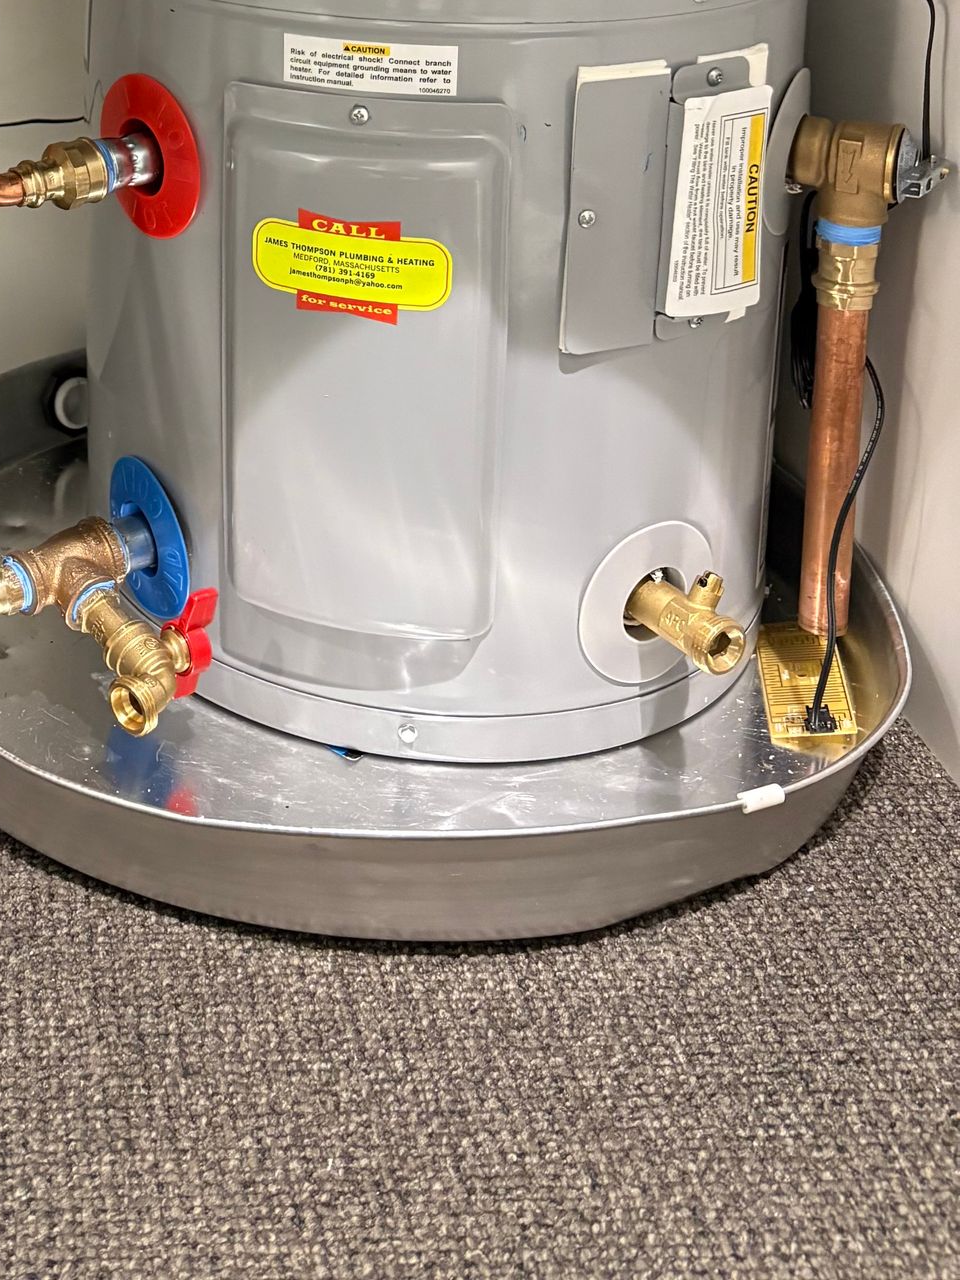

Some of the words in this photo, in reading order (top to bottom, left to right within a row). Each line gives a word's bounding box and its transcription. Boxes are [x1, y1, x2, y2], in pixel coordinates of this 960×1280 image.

[321, 53, 354, 61] electrical
[388, 58, 420, 66] Connect
[351, 46, 385, 54] CAUTION
[290, 57, 311, 65] circuit
[313, 60, 349, 69] equipment
[352, 64, 389, 74] grounding
[290, 65, 312, 73] heater.
[335, 71, 364, 79] detailed
[370, 73, 413, 82] information
[290, 73, 325, 83] instruction
[326, 79, 354, 87] manual.
[739, 127, 747, 160] Improper
[728, 174, 736, 205] property
[736, 163, 744, 203] installation
[745, 164, 759, 233] CAUTION
[312, 219, 385, 239] CALL
[264, 236, 288, 248] JAMES
[291, 242, 336, 257] THOMPSON
[339, 251, 384, 263] PLUMBING
[397, 257, 435, 267] HEATING
[293, 252, 330, 266] MEDFORD,
[333, 259, 400, 273] MASSACHUSETTS
[315, 264, 336, 274] (781)
[339, 269, 375, 279] 391-4169
[289, 267, 403, 289] jamesthompsonph@yahoo.com
[301, 294, 326, 305] for
[329, 301, 392, 315] service
